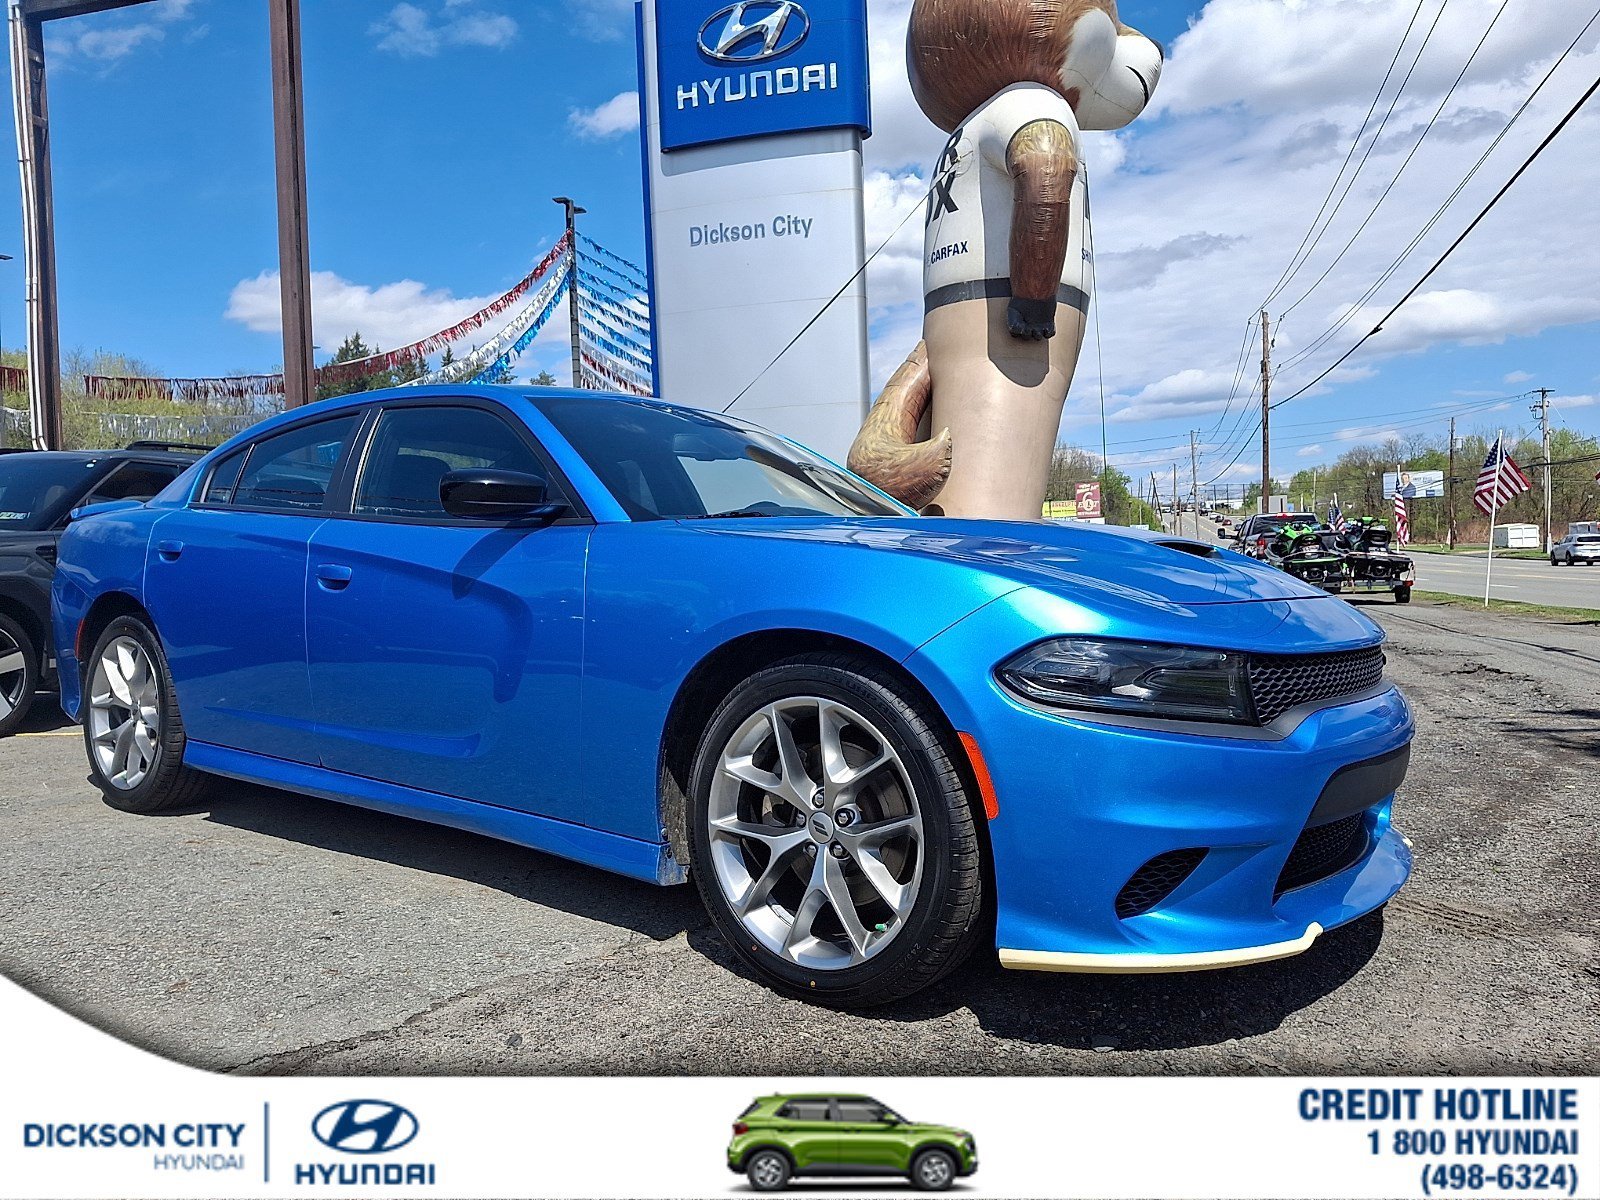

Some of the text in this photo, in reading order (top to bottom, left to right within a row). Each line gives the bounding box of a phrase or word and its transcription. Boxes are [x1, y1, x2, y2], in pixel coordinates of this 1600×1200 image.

[677, 63, 837, 110] HYUNDAI
[690, 214, 813, 247] Dickson City
[930, 240, 969, 265] CARFAX
